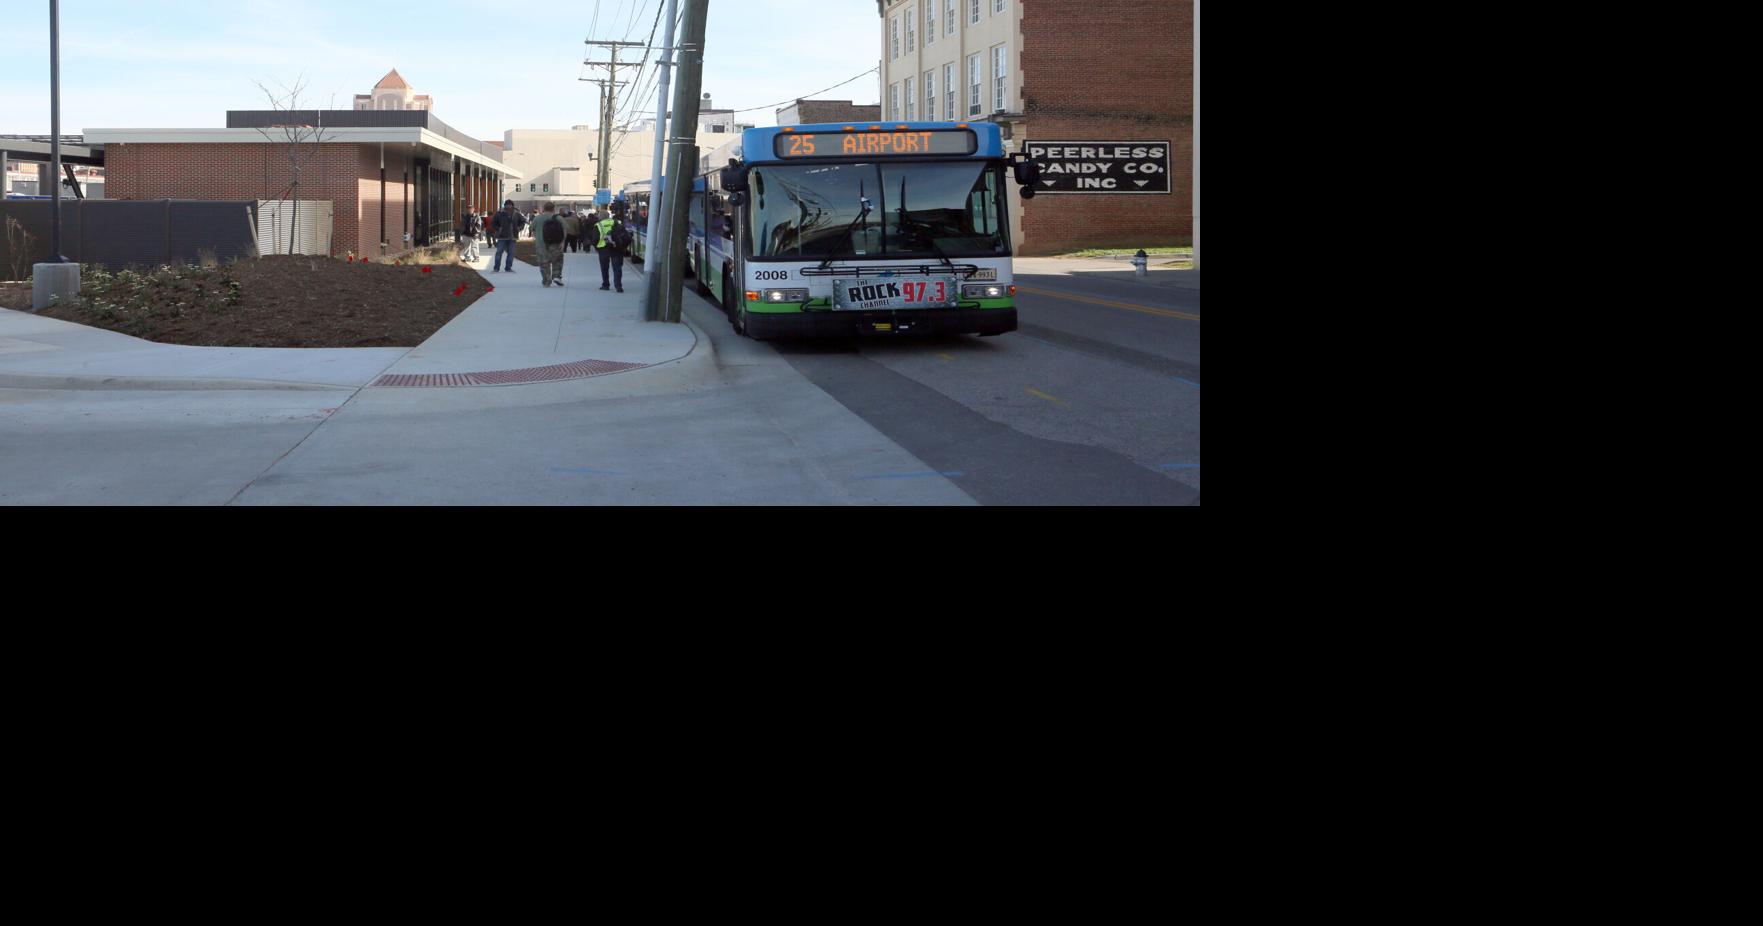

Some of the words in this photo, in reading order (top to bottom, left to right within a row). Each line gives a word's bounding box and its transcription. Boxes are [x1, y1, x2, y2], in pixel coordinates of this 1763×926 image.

[789, 134, 815, 155] 25
[842, 131, 932, 153] AIRPORT
[1030, 147, 1164, 159] PEERLESS
[1123, 162, 1164, 174] CO.
[1076, 178, 1117, 189] INC
[755, 270, 788, 281] 2008
[848, 282, 901, 303] ROCK
[902, 281, 946, 303] 97.3
[860, 299, 890, 309] CHANNEL
